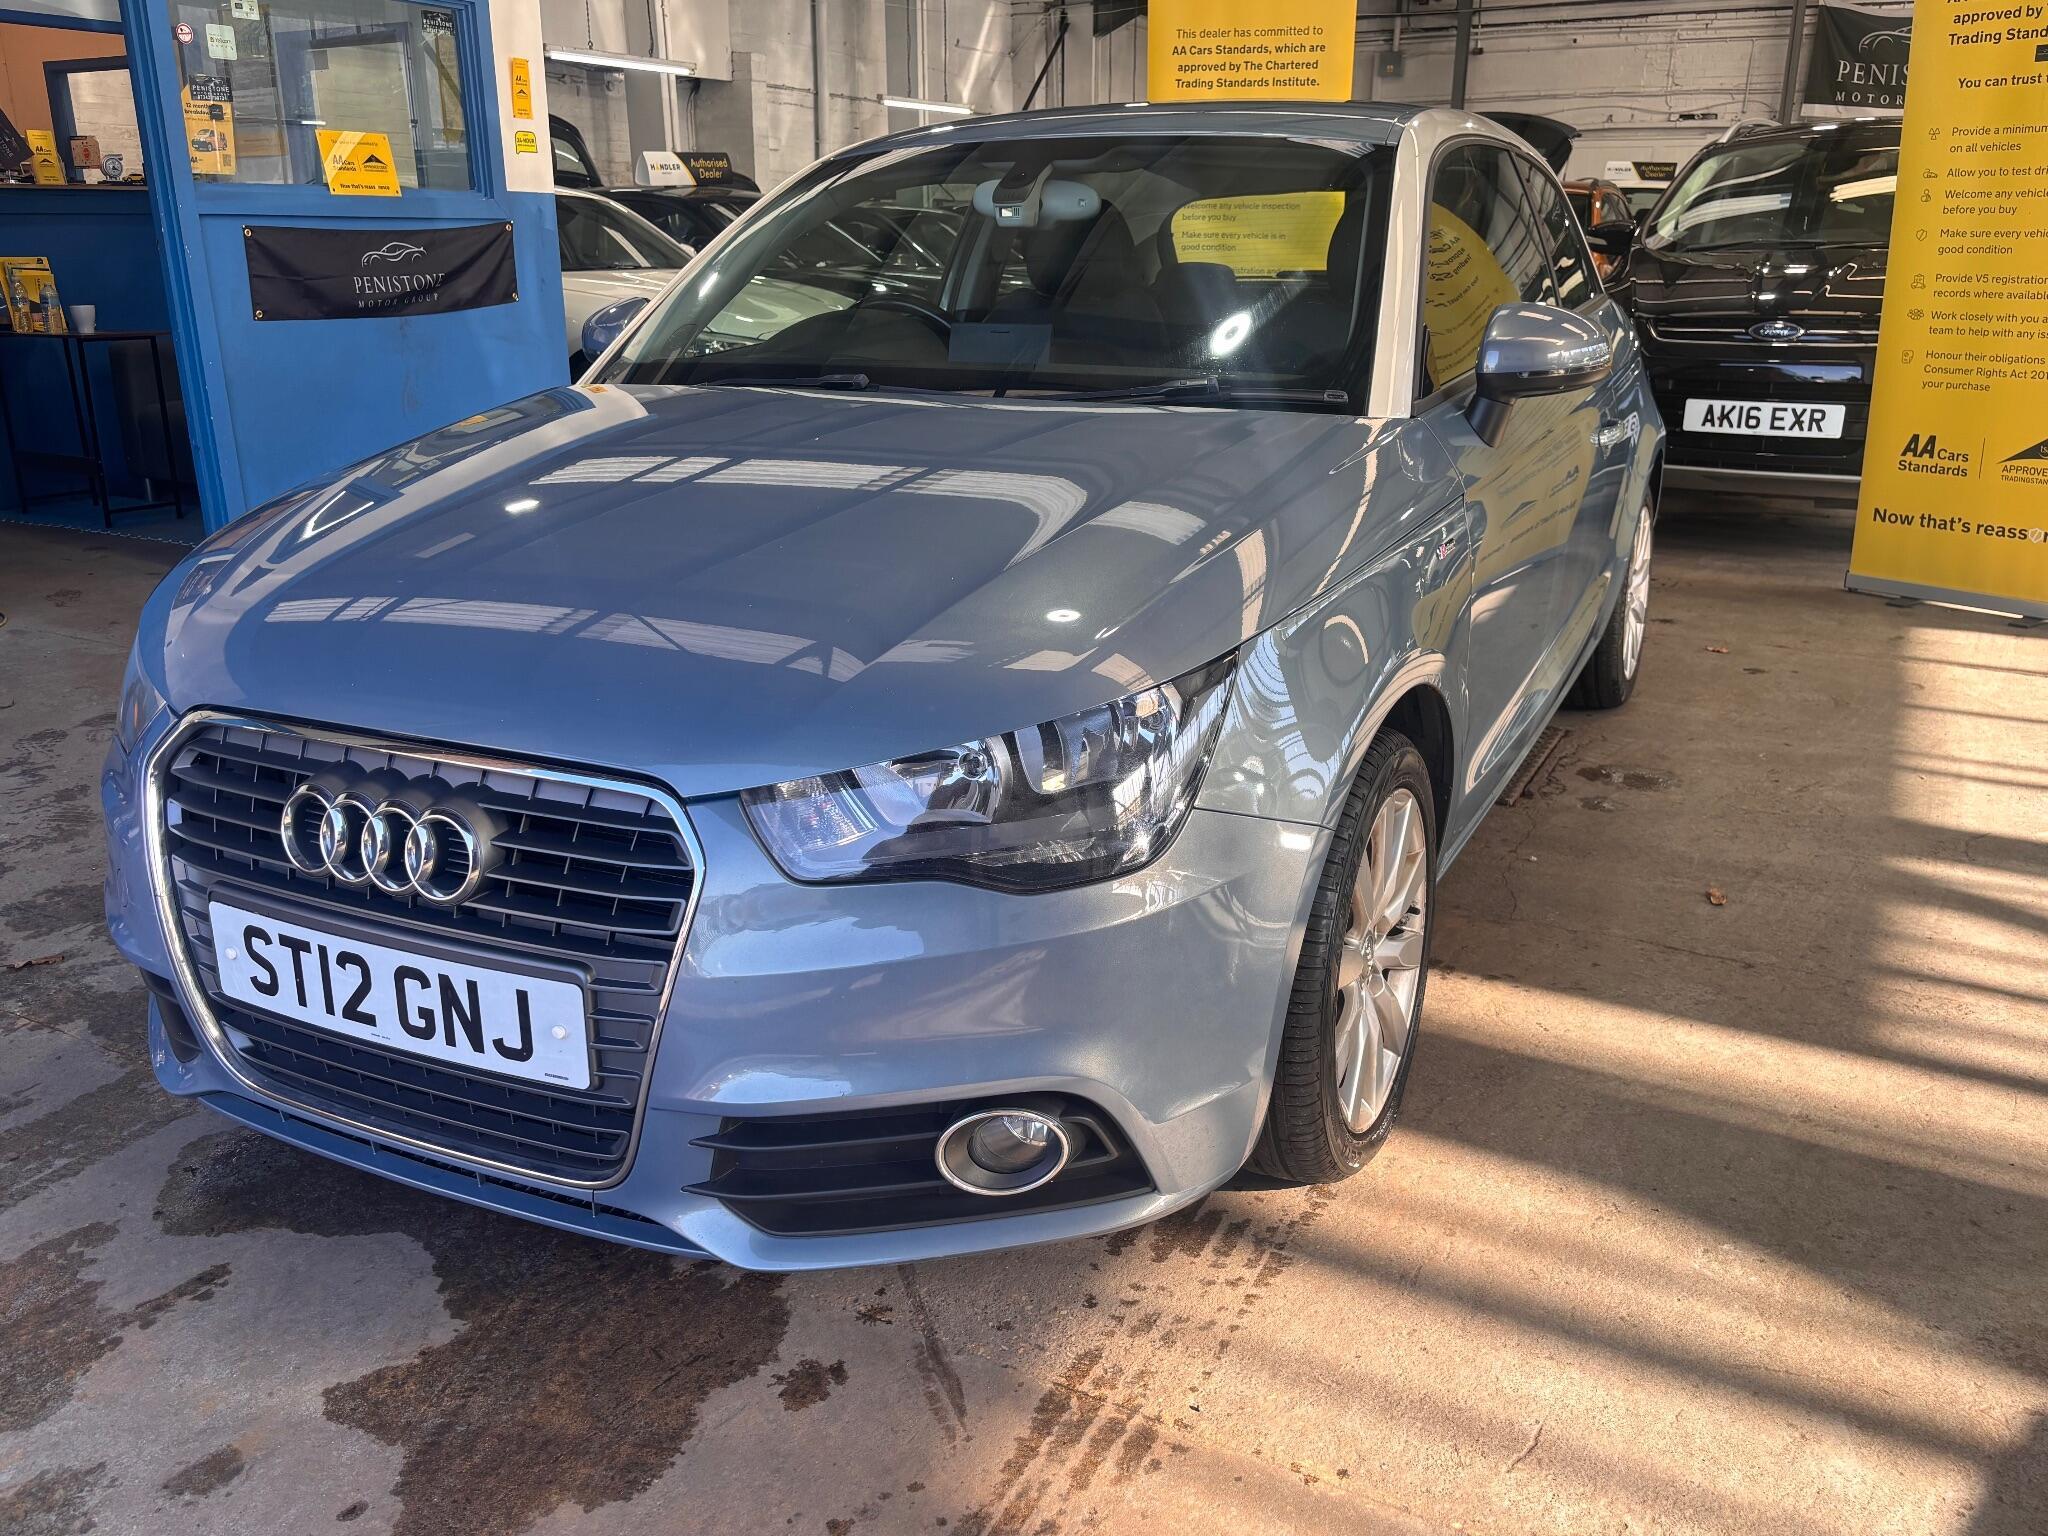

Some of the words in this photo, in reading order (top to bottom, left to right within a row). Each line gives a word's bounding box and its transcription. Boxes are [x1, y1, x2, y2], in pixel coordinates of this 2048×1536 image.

[1953, 6, 2022, 25] approved
[2026, 5, 2043, 19] by
[1176, 29, 1197, 39] This
[1199, 28, 1231, 39] dealer
[1233, 27, 1251, 38] has
[1254, 26, 1310, 38] committed
[1312, 26, 1323, 36] to
[1949, 31, 2001, 45] Trading
[1172, 46, 1187, 56] AA
[1189, 46, 1213, 56] Cars
[1215, 45, 1272, 56] Standards,
[1274, 43, 1306, 54] which
[1308, 44, 1326, 53] are
[1177, 62, 1227, 73] approved
[1229, 62, 1241, 73] by
[1243, 61, 1264, 71] The
[1265, 60, 1318, 71] Chartered
[1175, 79, 1214, 90] Trading
[1216, 78, 1270, 89] Standards
[1272, 77, 1320, 87] Institute.
[1958, 78, 1981, 88] You
[1985, 77, 2007, 87] can
[2011, 73, 2042, 85] trust
[1835, 91, 1904, 105] MOTOR
[1952, 126, 1991, 136] Provide
[2002, 124, 2048, 134] minimum
[1949, 145, 1963, 153] on
[1965, 143, 1978, 152] all
[1980, 142, 2022, 152] vehicles
[690, 158, 728, 168] Authorised
[700, 168, 722, 179] Dealer
[1947, 167, 1975, 178] Allow
[1978, 169, 1996, 178] you
[2000, 167, 2009, 176] to
[2012, 166, 2032, 176] test
[1945, 189, 1992, 199] Welcome
[1995, 190, 2013, 200] any
[1233, 201, 1260, 210] vehicle
[1942, 205, 1975, 214] before
[1978, 206, 1996, 215] you
[1999, 205, 2017, 215] buy
[1182, 213, 1207, 221] before
[1208, 214, 1221, 223] you
[1222, 213, 1236, 223] buy
[1182, 231, 1202, 240] Make
[1203, 232, 1220, 240] sure
[1221, 232, 1241, 241] every
[1242, 231, 1269, 240] vehicle
[1940, 229, 1967, 238] Make
[1969, 230, 1991, 238] sure
[1993, 230, 2021, 239] every
[1181, 243, 1200, 252] good
[1201, 243, 1236, 251] condition
[1938, 245, 1963, 255] good
[1966, 245, 2013, 254] condition
[353, 273, 445, 294] PENISTONE
[1935, 274, 1973, 283] Provide
[1976, 274, 1989, 283] V5
[1933, 289, 1971, 298] records
[1974, 290, 2004, 299] where
[2006, 290, 2048, 300] availabl
[1931, 311, 1957, 321] Work
[1960, 312, 1993, 323] closely
[1996, 313, 2018, 323] with
[2020, 315, 2039, 324] you
[1929, 326, 1953, 335] team
[1956, 327, 1965, 335] to
[1968, 327, 1989, 338] help
[1992, 328, 2013, 338] with
[2016, 331, 2035, 340] any
[1926, 350, 1962, 360] Honour
[1965, 352, 1987, 362] their
[1988, 354, 2046, 365] obligations
[1924, 364, 1973, 376] Consumer
[1976, 367, 2007, 378] Rights
[2009, 369, 2027, 379] Act
[1922, 380, 1944, 389] your
[1945, 380, 1991, 392] purchase
[1701, 404, 1762, 430] AK16
[1769, 407, 1826, 433] EXR
[1900, 433, 1937, 459] AA
[1937, 448, 1969, 463] Cars
[1898, 459, 1968, 478] Standards
[1873, 507, 1915, 526] Now
[1919, 513, 1971, 533] that's
[243, 923, 378, 1028] ST12
[393, 964, 535, 1063] GNJ
